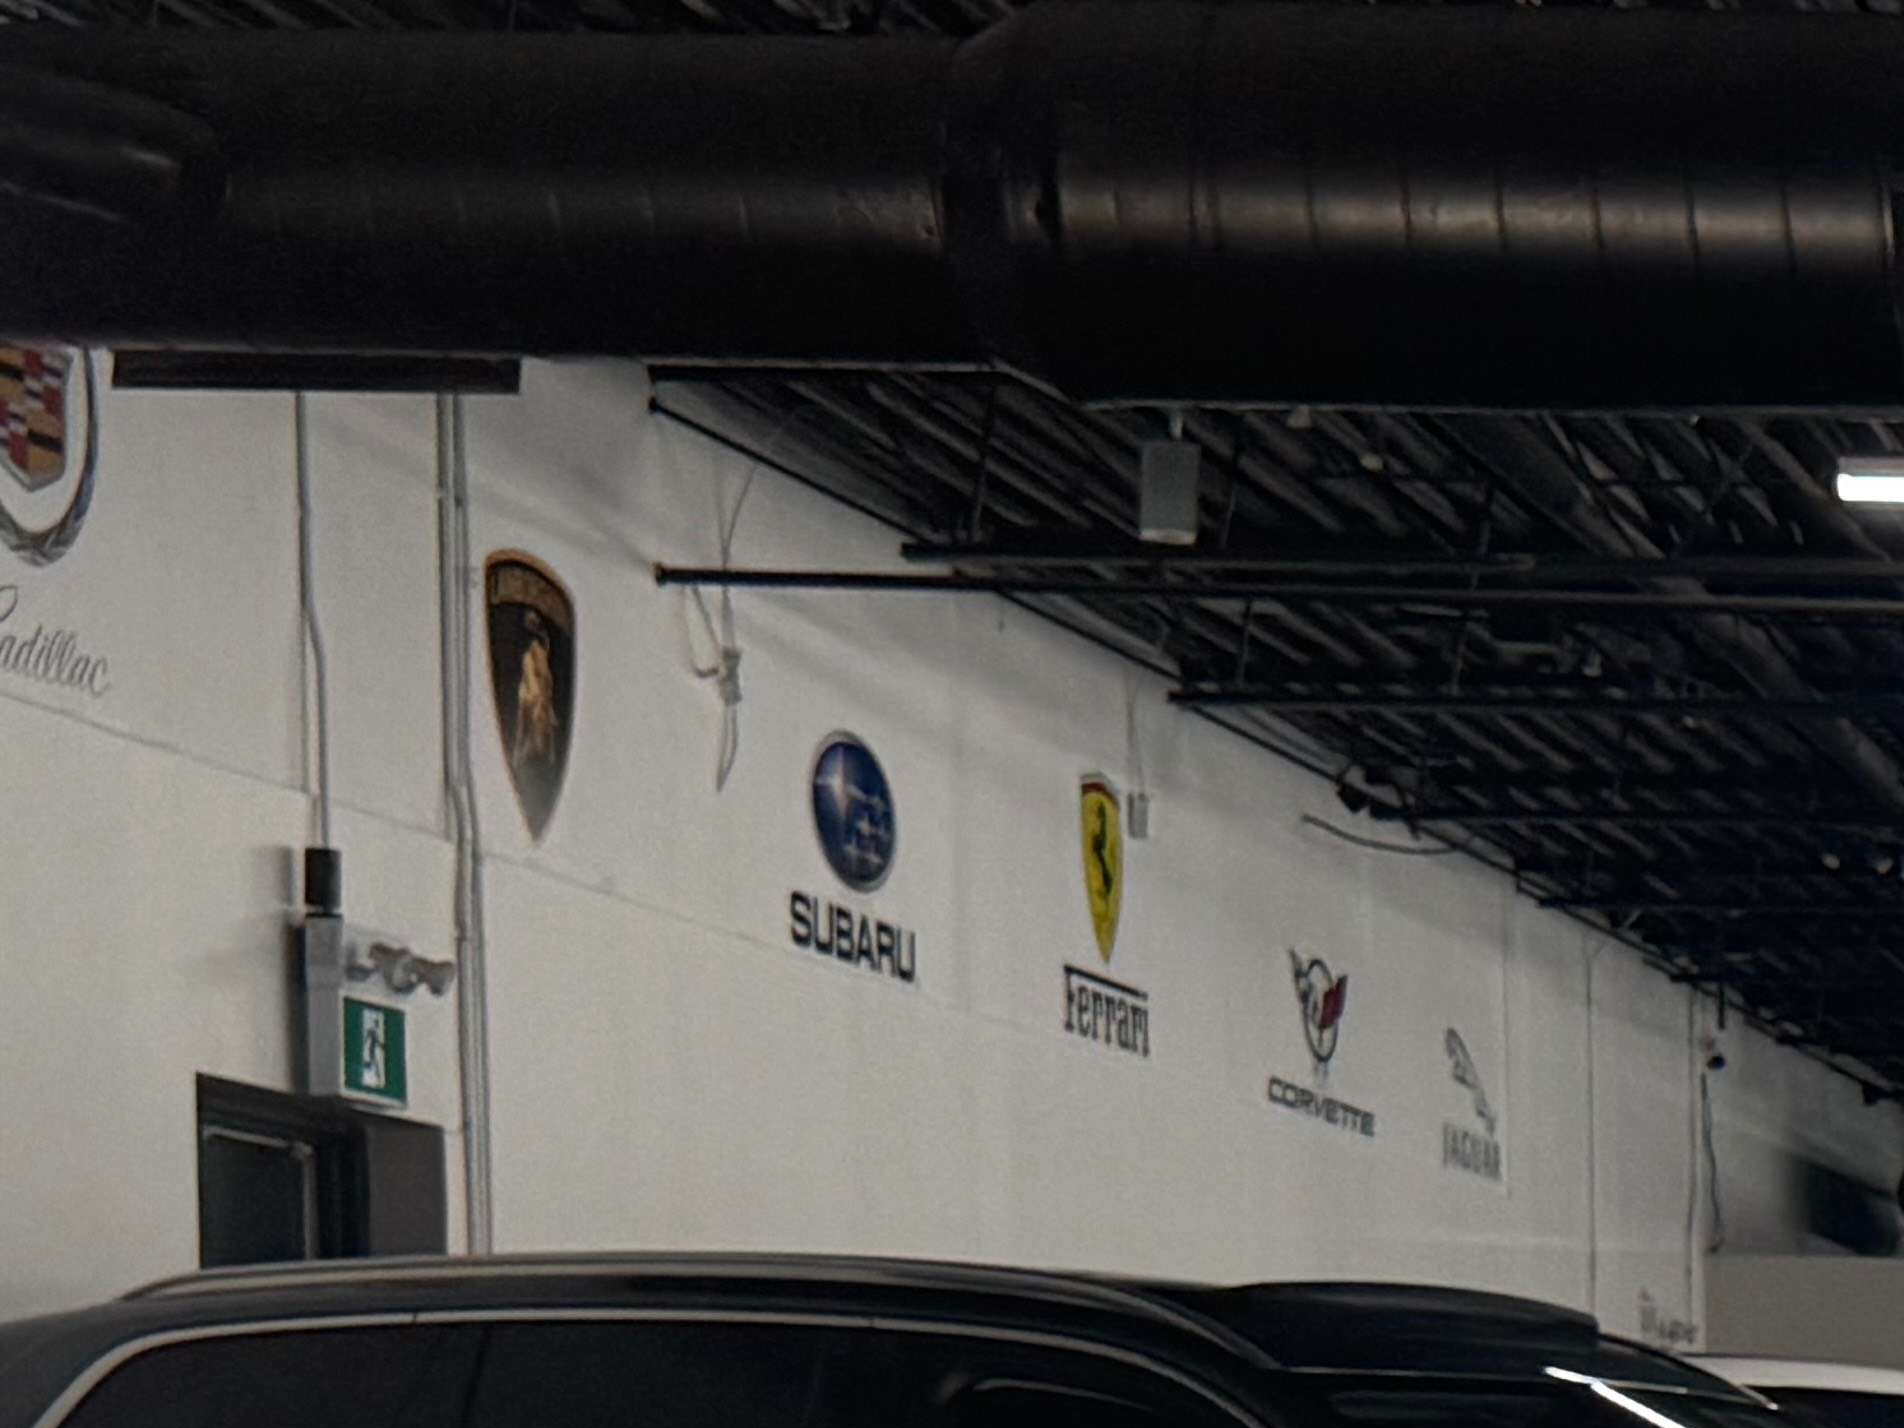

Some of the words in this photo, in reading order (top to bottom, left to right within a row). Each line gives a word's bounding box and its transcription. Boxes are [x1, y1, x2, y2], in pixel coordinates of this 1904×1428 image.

[790, 890, 916, 984] SUBARU
[1063, 964, 1150, 1058] Ferrari
[1267, 1075, 1375, 1138] CORVETTE
